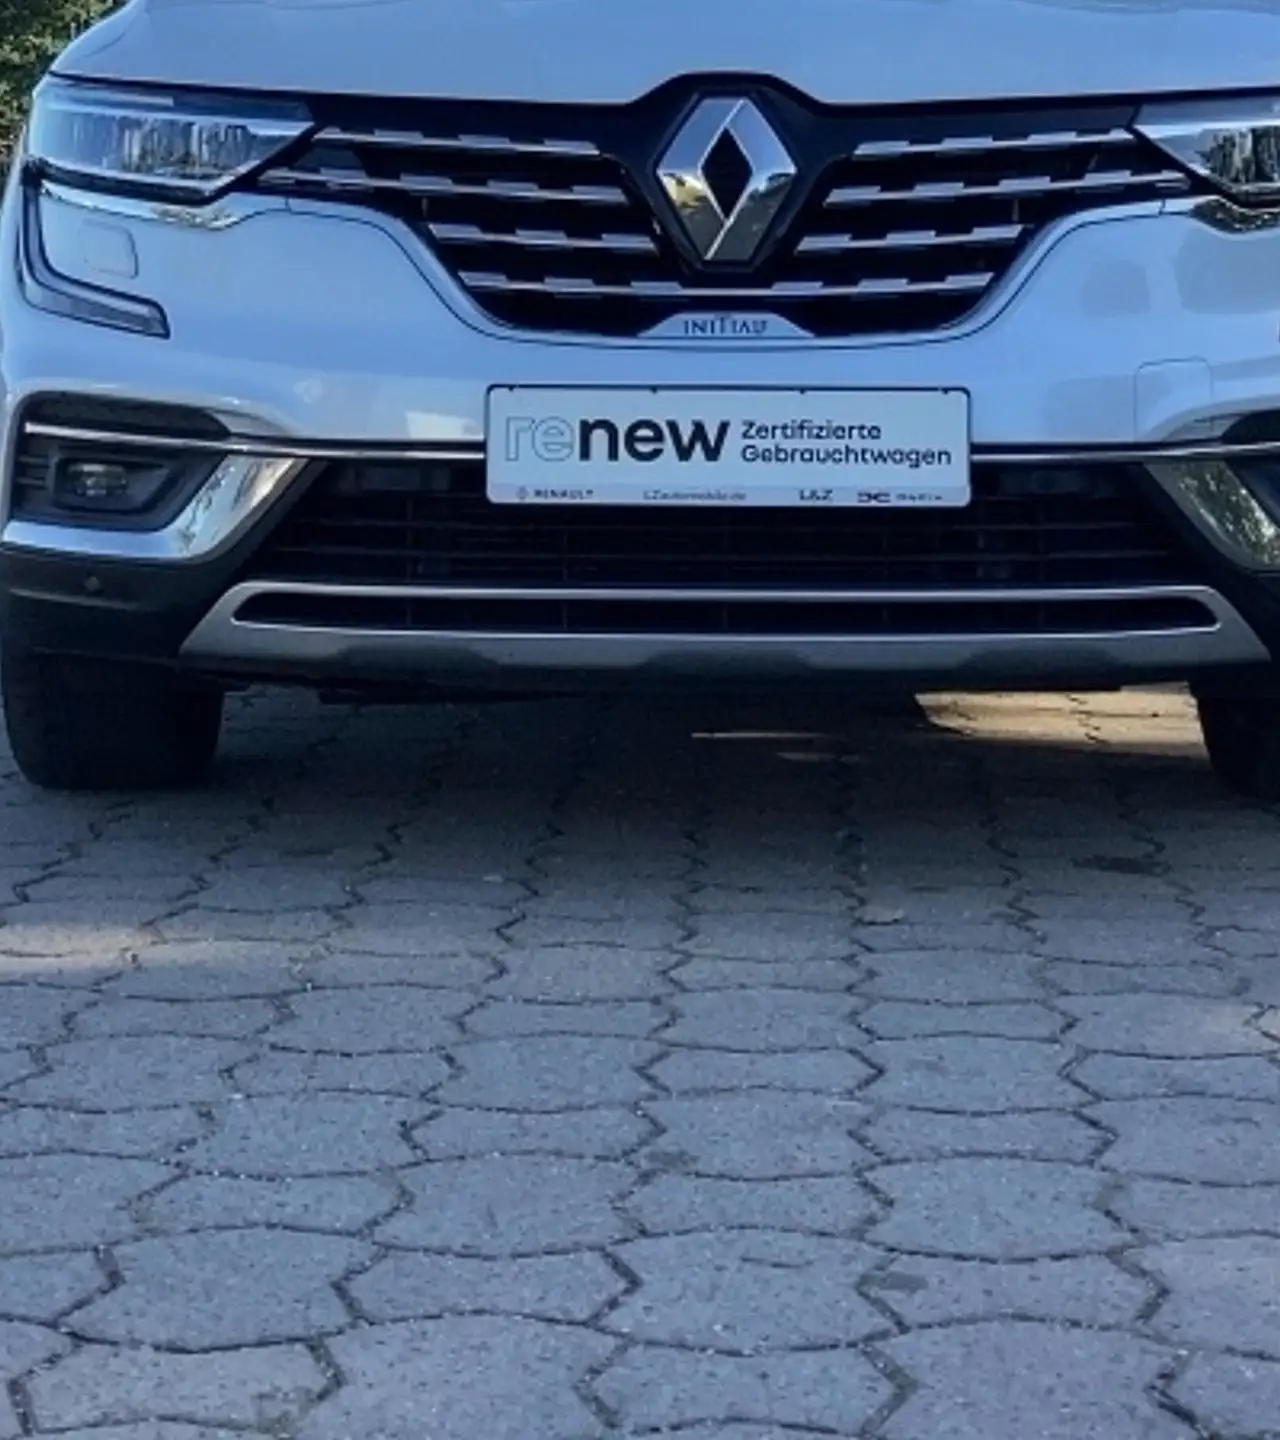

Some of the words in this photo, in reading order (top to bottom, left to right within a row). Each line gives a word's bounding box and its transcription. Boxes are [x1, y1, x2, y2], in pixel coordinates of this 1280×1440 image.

[505, 416, 731, 463] renew
[741, 419, 882, 440] Zertifizierte
[741, 444, 953, 469] Gebrauchtwagen
